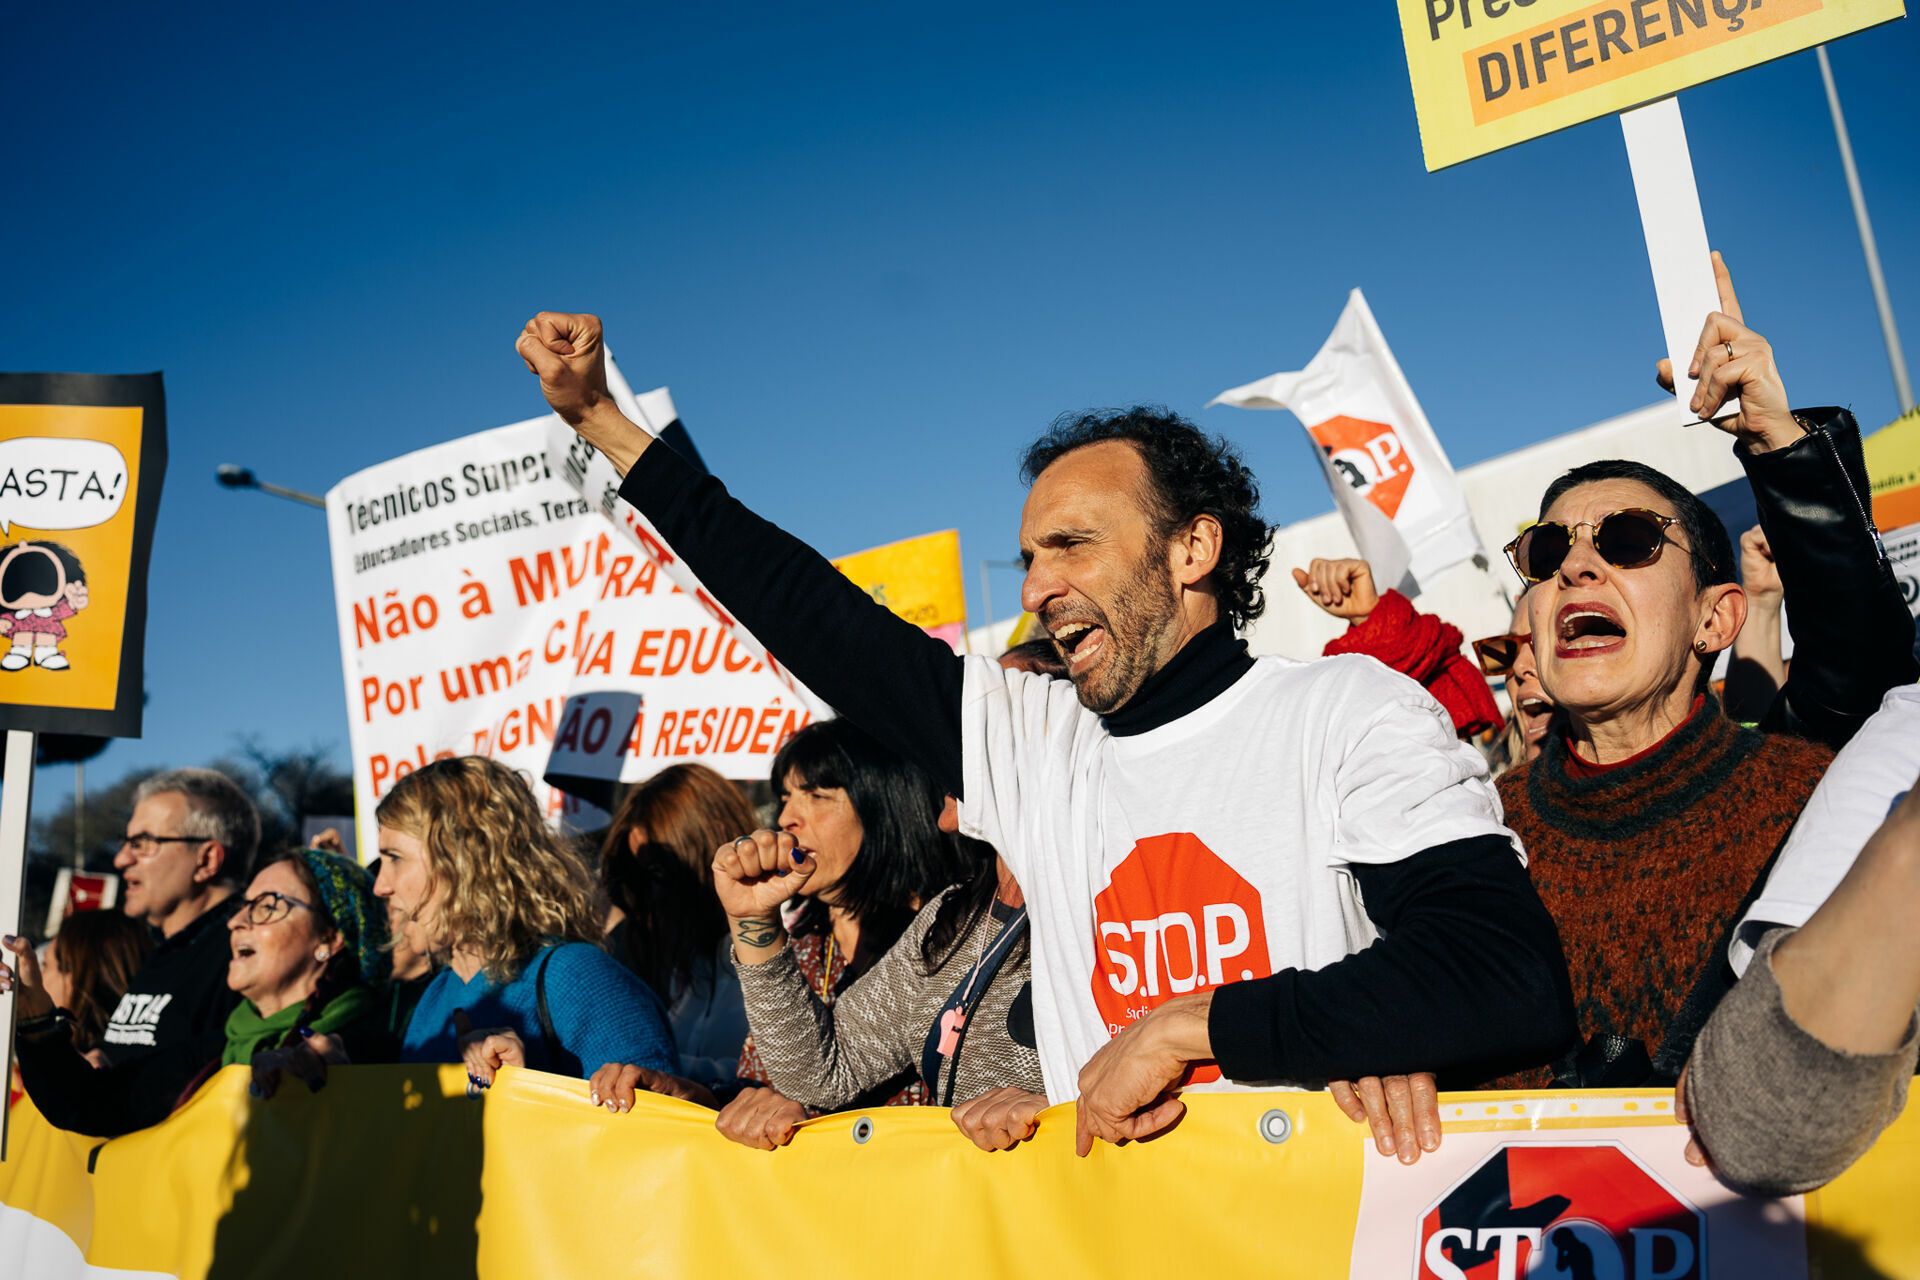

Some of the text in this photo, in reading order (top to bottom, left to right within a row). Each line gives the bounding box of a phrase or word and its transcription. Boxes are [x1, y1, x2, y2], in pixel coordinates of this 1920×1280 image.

[1425, 0, 1538, 41] Pre
[1477, 0, 1763, 103] DIFERENÇ
[541, 497, 594, 522] Tera
[353, 592, 438, 649] Não
[460, 569, 494, 619] à
[361, 673, 425, 723] Por
[440, 648, 532, 704] uma
[629, 626, 763, 677] EDUC
